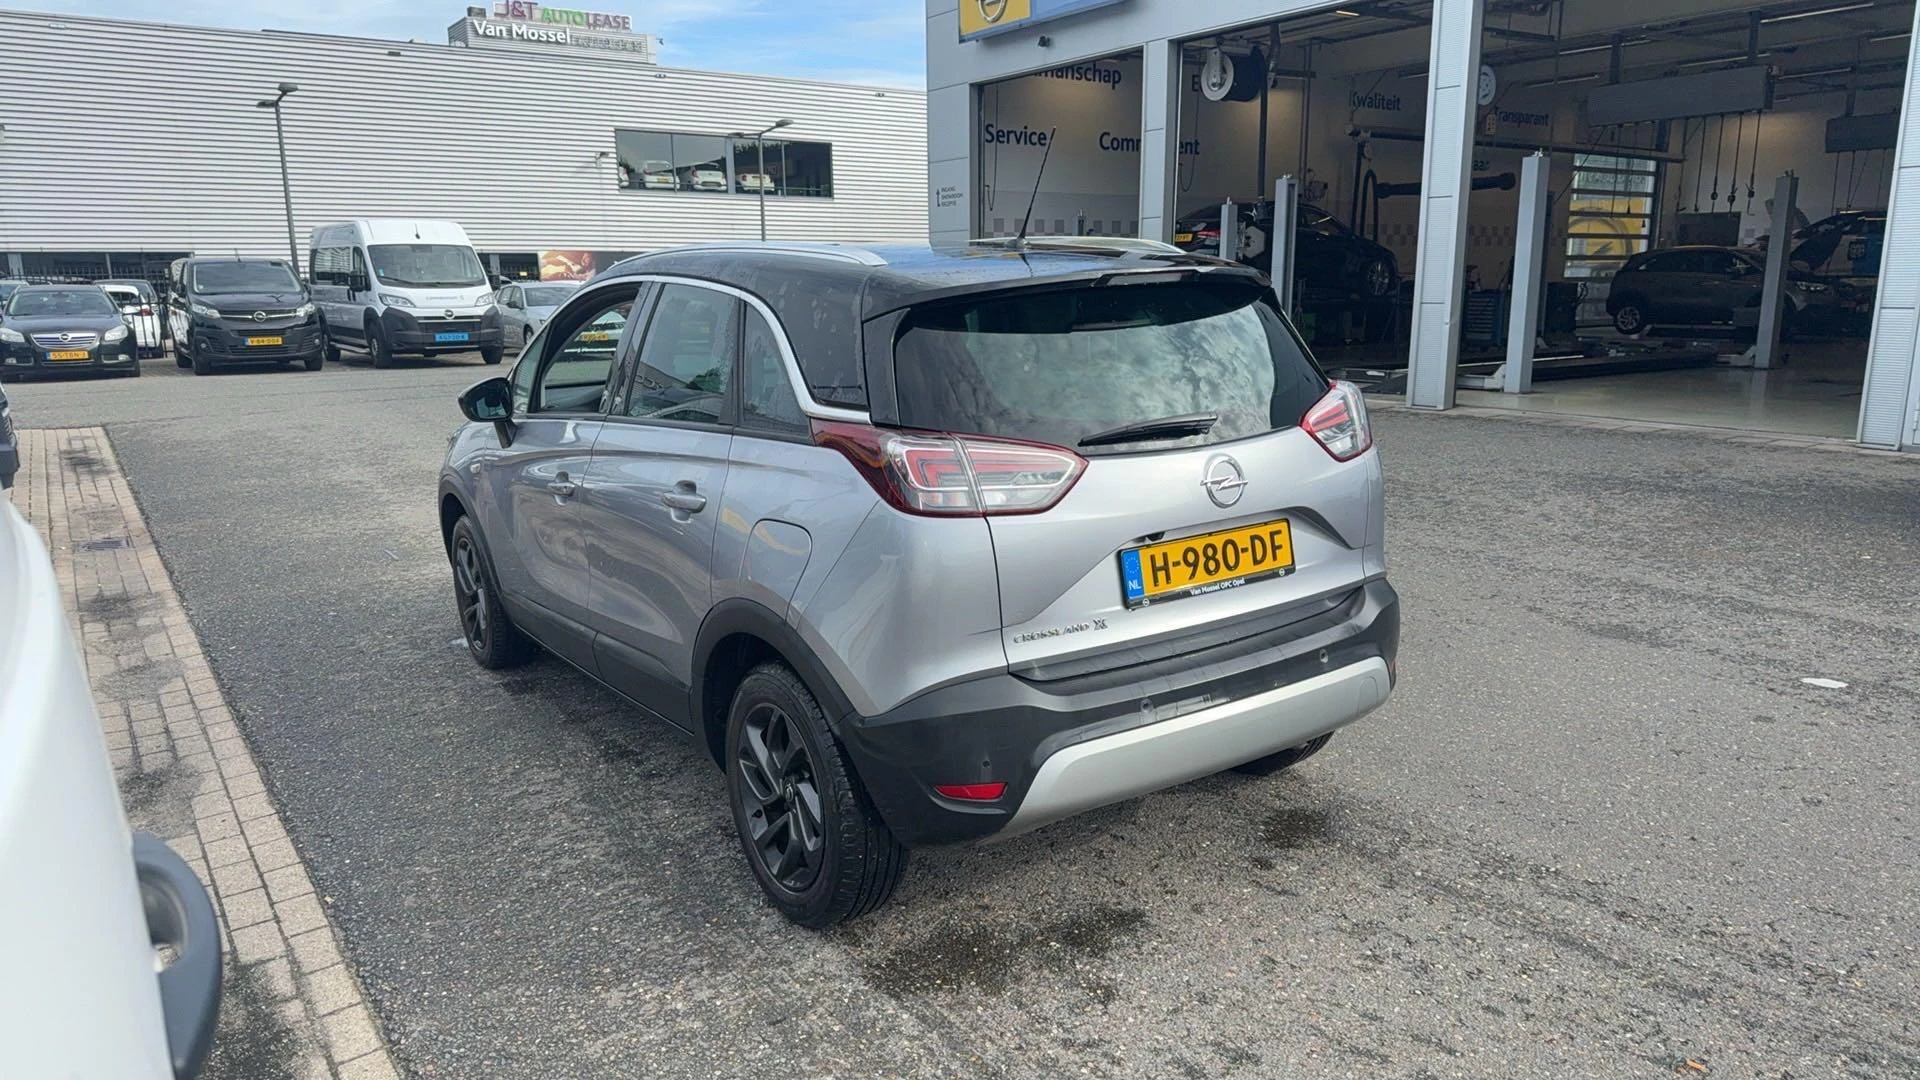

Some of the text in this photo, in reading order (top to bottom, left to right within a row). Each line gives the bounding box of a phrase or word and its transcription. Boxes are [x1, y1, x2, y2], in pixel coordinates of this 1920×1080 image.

[494, 0, 632, 30] J&T AUTOLEASE
[473, 20, 507, 37] Van
[511, 23, 571, 44] Mossel
[985, 124, 1047, 147] Service
[1150, 530, 1283, 587] H-980-DF
[1128, 579, 1142, 591] NL
[1013, 617, 1108, 643] CROSSLAND X
